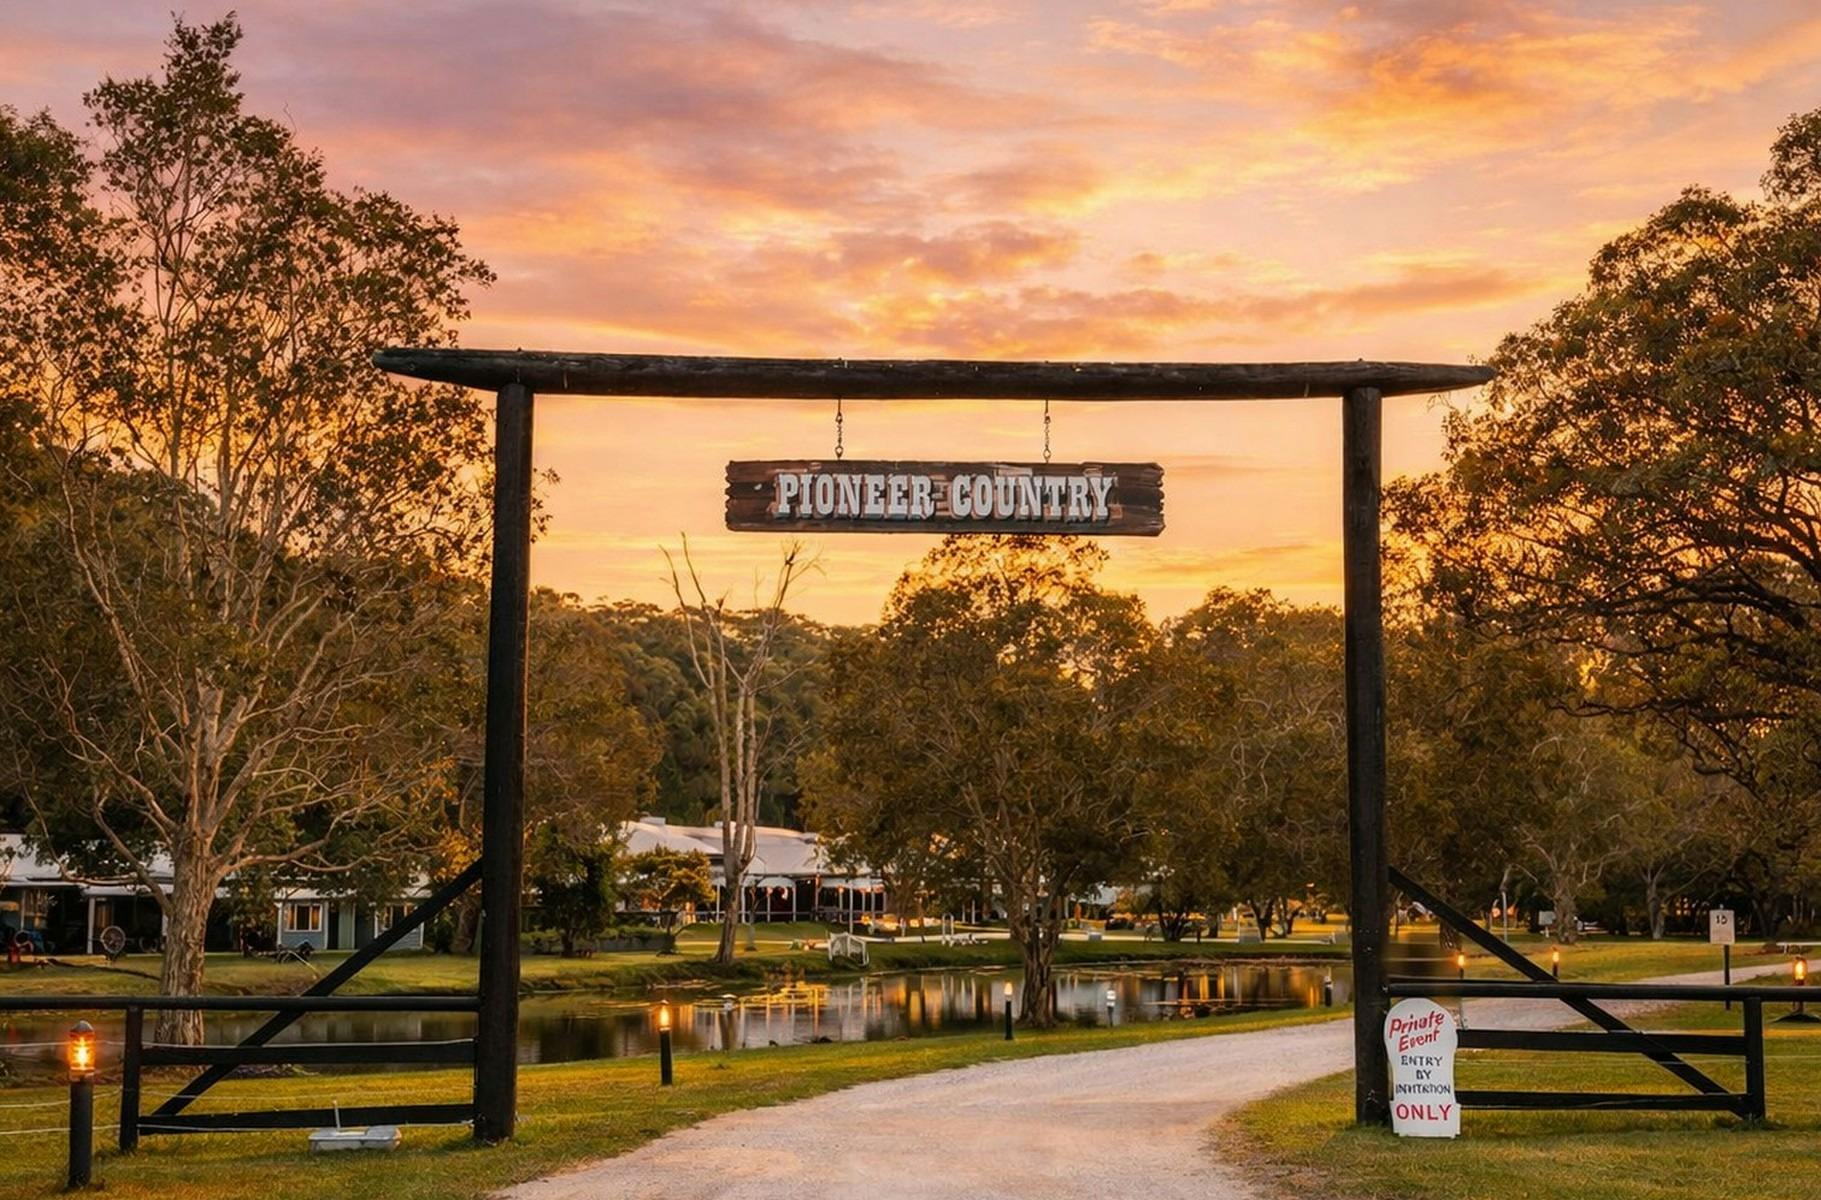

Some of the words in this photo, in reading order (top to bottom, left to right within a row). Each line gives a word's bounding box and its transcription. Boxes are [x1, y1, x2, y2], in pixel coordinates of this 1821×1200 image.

[776, 473, 936, 519] PIONEER
[951, 473, 1116, 521] COUNTRY
[1389, 1010, 1445, 1039] Private
[1398, 1029, 1440, 1053] Event
[1401, 1055, 1443, 1067] ENTRY
[1416, 1069, 1432, 1080] BY
[1396, 1103, 1452, 1121] ONLY
